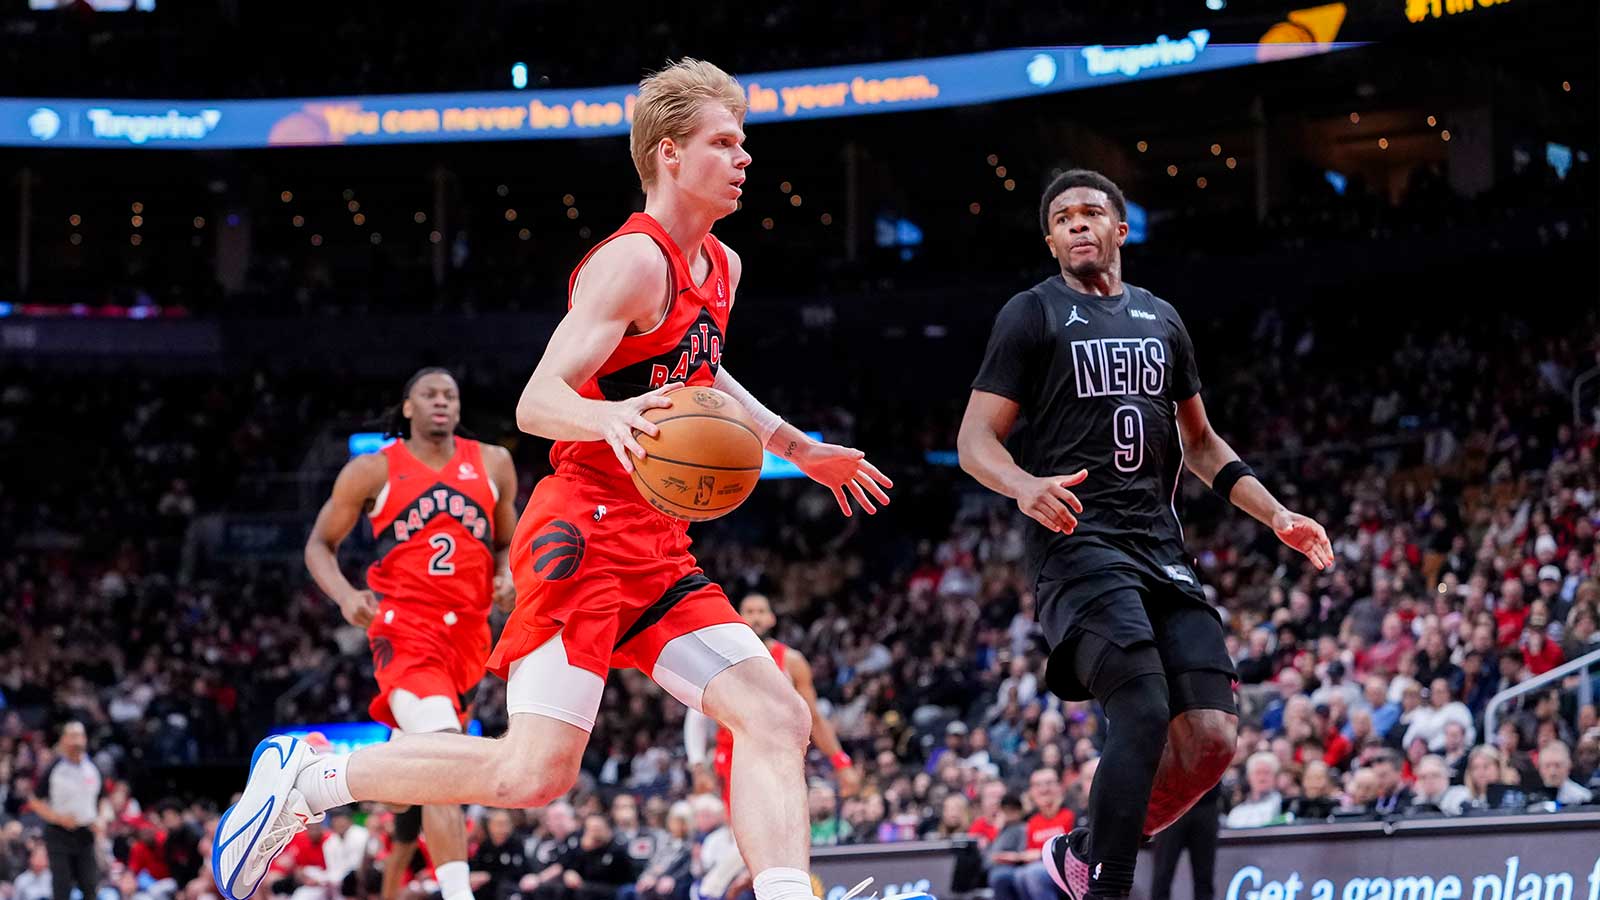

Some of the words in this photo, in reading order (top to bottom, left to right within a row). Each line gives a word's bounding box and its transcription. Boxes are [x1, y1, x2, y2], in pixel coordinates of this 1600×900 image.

[1081, 34, 1197, 77] Tangerine
[324, 105, 379, 135] You
[382, 109, 440, 133] can
[442, 106, 527, 131] never
[530, 98, 570, 129] be
[572, 99, 623, 127] too
[748, 83, 778, 112] in
[781, 82, 849, 116] your
[87, 108, 206, 144] Tangerine
[649, 323, 722, 388] RAPTO
[1070, 337, 1166, 398] NETS
[1113, 405, 1145, 473] 9
[393, 489, 487, 541] RAPTORS
[428, 532, 457, 576] 2
[1225, 865, 1304, 900] Get
[1311, 878, 1335, 900] a
[1342, 875, 1462, 900] game
[1472, 855, 1574, 900] plan
